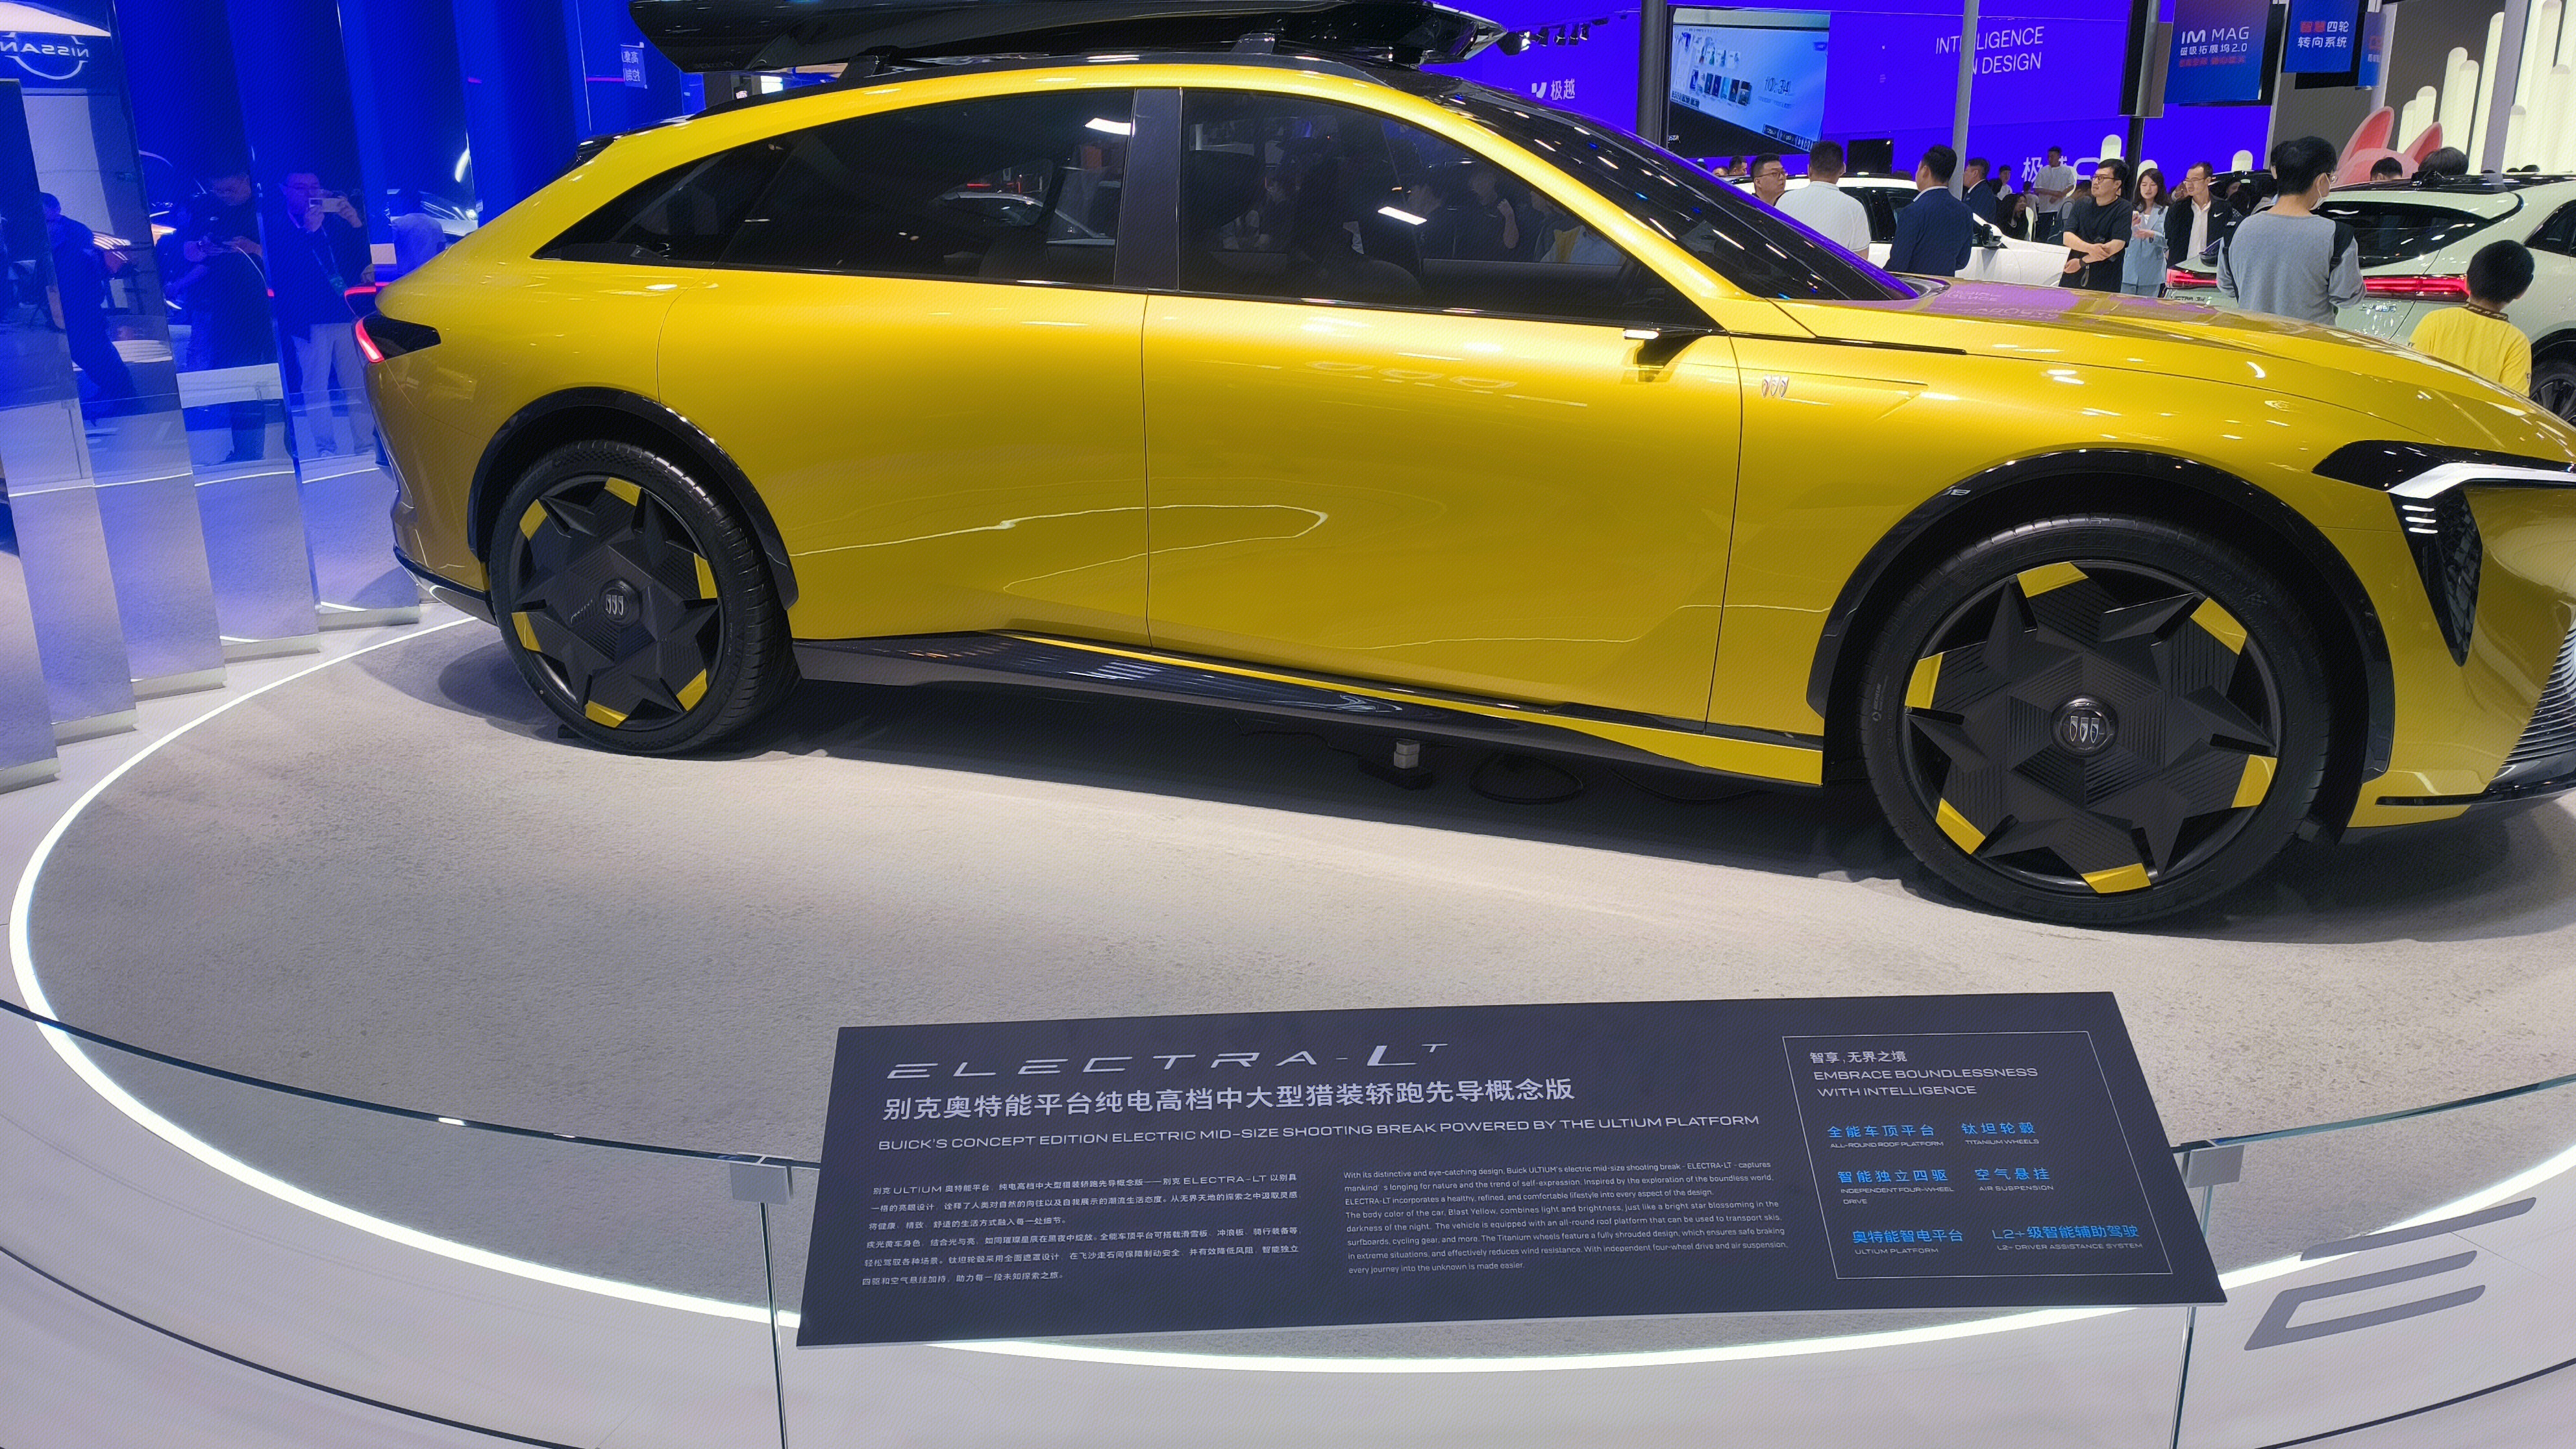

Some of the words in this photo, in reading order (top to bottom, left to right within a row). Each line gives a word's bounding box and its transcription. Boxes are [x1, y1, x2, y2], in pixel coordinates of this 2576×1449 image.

[1936, 26, 2044, 54] INTLIGENCE
[2181, 29, 2206, 44] IM
[2211, 27, 2249, 42] MAG
[2297, 36, 2347, 49] 转向系统
[1981, 52, 2042, 75] DESIGN
[1550, 78, 1576, 101] 极越
[1814, 1071, 1892, 1080] EMBRACE
[1895, 1068, 2037, 1079] BOUNDLESSNESS
[883, 1078, 1575, 1121] 别克奥特能平台纯电高档中大型猎装轿跑先导概念版
[1817, 1087, 1860, 1097] WITH
[1864, 1085, 1976, 1096] INTELLIGENCE
[952, 1135, 1035, 1148] CONCEPT
[1040, 1133, 1108, 1146] EDITION
[1113, 1131, 1195, 1144] ELECTRIC
[1283, 1126, 1372, 1139] SHOOTING
[1377, 1124, 1436, 1137] BREAK
[1440, 1121, 1529, 1135] POWERED
[1533, 1121, 1555, 1132] BY
[1559, 1120, 1594, 1132] THE
[1599, 1118, 1661, 1130] ULTIUM
[1666, 1115, 1759, 1128] PLATFORM
[1827, 1124, 1935, 1138] 全能车顶平台
[1344, 1170, 1361, 1179] With
[1363, 1170, 1372, 1178] its
[1374, 1169, 1411, 1178] distinctive
[1413, 1169, 1427, 1177] and
[1507, 1166, 1527, 1175] Buick
[1565, 1164, 1591, 1173] electric
[1626, 1163, 1658, 1174] shooting
[1659, 1162, 1680, 1171] break
[1687, 1161, 1731, 1170] ELECTRA-LT
[1739, 1160, 1770, 1171] captures
[1838, 1170, 1949, 1183] 智能独立四驱
[1974, 1167, 2051, 1181] 空气悬挂
[873, 1187, 891, 1195] 别克
[894, 1185, 941, 1195] ULTIUM
[1183, 1174, 1267, 1185] ELECTRA-LT
[1270, 1173, 1297, 1182] 以别具
[1390, 1182, 1418, 1193] longing
[1420, 1181, 1430, 1190] for
[1433, 1180, 1457, 1189] nature
[1459, 1180, 1474, 1189] and
[1476, 1180, 1487, 1188] the
[1490, 1179, 1510, 1188] trend
[1513, 1179, 1519, 1187] of
[1584, 1176, 1615, 1188] Inspired
[1616, 1176, 1625, 1187] by
[1627, 1176, 1640, 1185] the
[1642, 1175, 1684, 1187] exploration
[1686, 1174, 1693, 1183] of
[1695, 1174, 1707, 1183] the
[1709, 1173, 1748, 1183] boundless
[1345, 1196, 1391, 1206] ELECTRA-LT
[1393, 1195, 1439, 1206] incorporates
[1507, 1193, 1521, 1201] and
[1523, 1191, 1568, 1201] comfortable
[1570, 1191, 1598, 1202] lifestyle
[1600, 1190, 1615, 1199] into
[1616, 1192, 1636, 1201] every
[1638, 1189, 1663, 1200] aspect
[1665, 1189, 1671, 1197] of
[1674, 1189, 1685, 1197] the
[1346, 1210, 1360, 1219] The
[1363, 1209, 1381, 1220] body
[1384, 1209, 1404, 1218] color
[1406, 1209, 1414, 1217] of
[1417, 1208, 1429, 1217] the
[1448, 1208, 1468, 1216] Blast
[1500, 1206, 1539, 1215] combines
[1541, 1205, 1559, 1216] light
[1561, 1204, 1576, 1213] and
[1625, 1203, 1640, 1214] just
[1642, 1202, 1655, 1211] like
[1665, 1202, 1688, 1213] bright
[1691, 1201, 1705, 1210] star
[1708, 1200, 1754, 1212] blossoming
[1756, 1200, 1763, 1208] in
[1766, 1200, 1778, 1208] the
[1393, 1235, 1419, 1246] cycling
[1442, 1235, 1455, 1243] and
[1481, 1233, 1496, 1242] The
[1497, 1233, 1531, 1242] Titanium
[1533, 1232, 1559, 1241] wheels
[1562, 1231, 1589, 1240] feature
[1597, 1230, 1613, 1241] fully
[1615, 1230, 1650, 1239] shrouded
[1682, 1228, 1705, 1237] which
[1739, 1227, 1755, 1235] safe
[1756, 1226, 1785, 1237] braking
[1852, 1229, 1964, 1243] 奥特能智电平台
